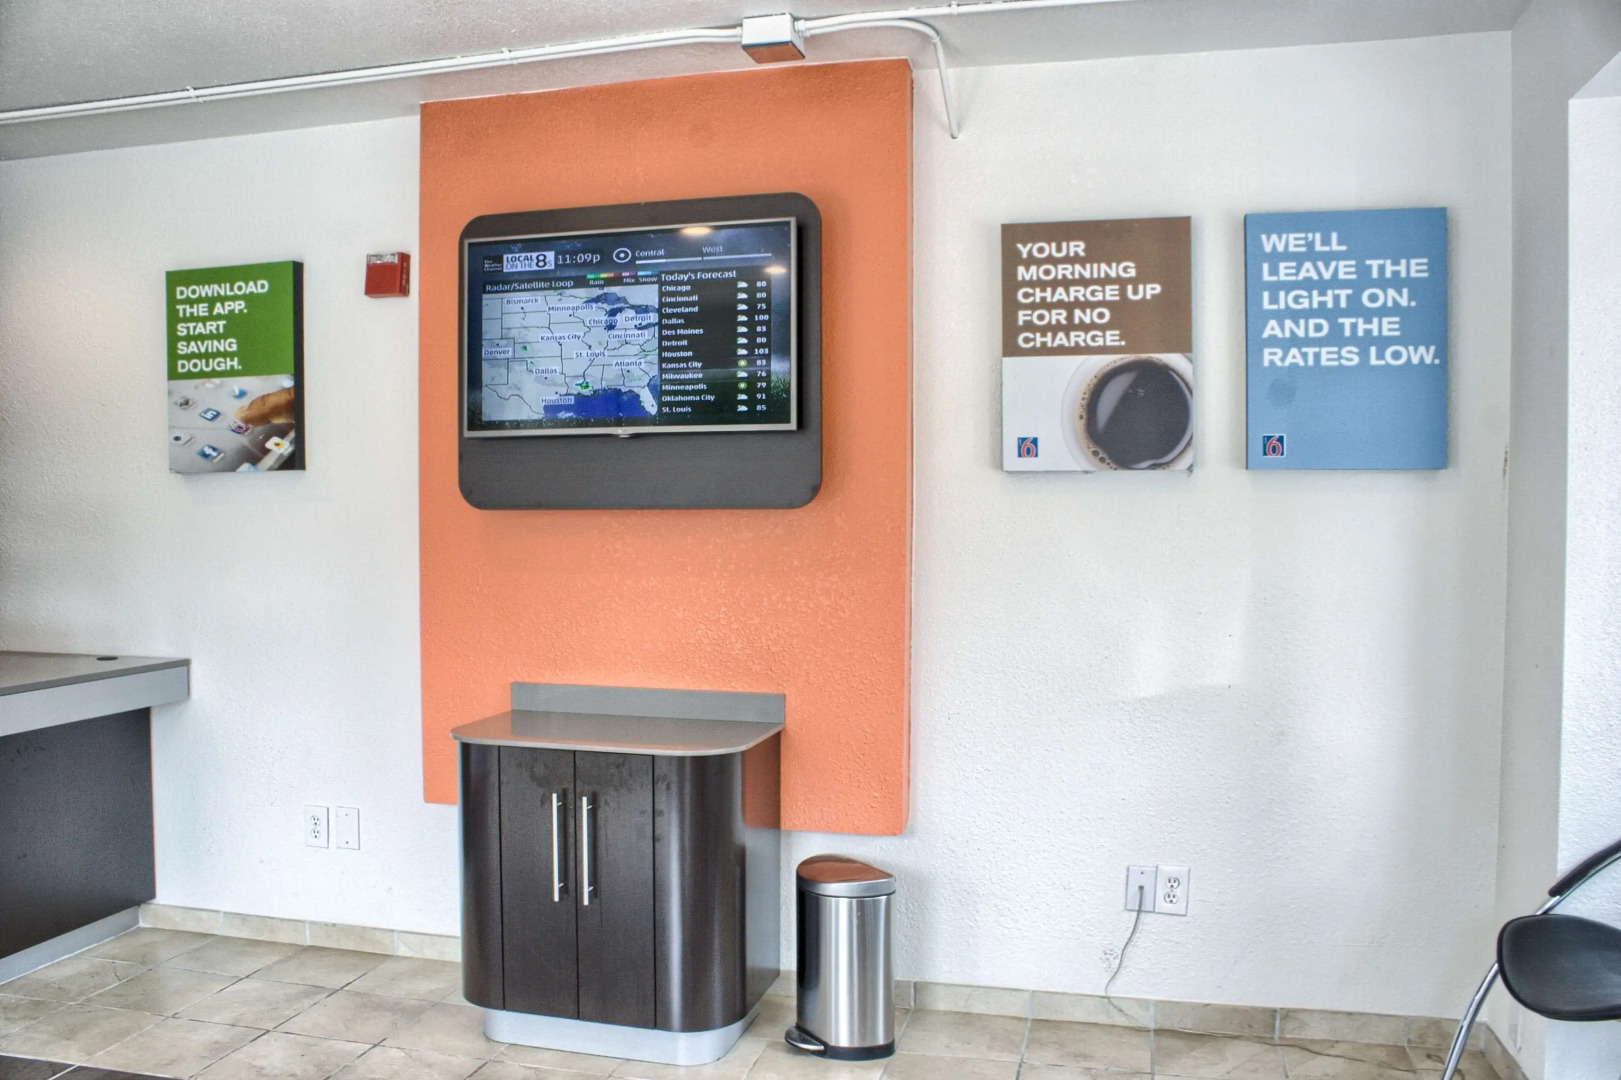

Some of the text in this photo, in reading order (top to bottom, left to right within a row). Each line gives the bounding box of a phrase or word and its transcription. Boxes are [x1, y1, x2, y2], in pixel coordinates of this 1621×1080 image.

[1261, 232, 1347, 253] WE'LL
[635, 246, 724, 258] Central West
[1016, 241, 1086, 259] YOUR
[506, 255, 534, 263] LOCAL
[506, 261, 534, 270] ON THE
[557, 253, 601, 265] 11:09p
[661, 270, 737, 282] Today's Forecast
[1017, 262, 1137, 281] MORNING
[1262, 258, 1429, 281] LEAVE THE
[176, 279, 269, 300] DOWNLOAD
[486, 279, 574, 292] Radar/Satellite Loop
[662, 285, 691, 293] Chicago
[662, 295, 698, 303] Cincinnati
[1017, 283, 1161, 304] CHARGE UP
[1262, 288, 1416, 310] LIGHT ON.
[506, 297, 540, 305] Bismarck
[176, 301, 248, 318] THE APP.
[548, 304, 594, 313] Minneapolis
[662, 306, 699, 314] Cleveland
[588, 318, 618, 326] Chicago
[1017, 308, 1111, 326] FOR NO
[177, 320, 227, 337] START
[1261, 317, 1401, 339] AND THE
[567, 333, 582, 342] City
[1017, 330, 1125, 348] CHARGE.
[177, 338, 238, 355] SAVING
[662, 350, 693, 358] Houston
[1263, 345, 1440, 367] RATES LOW.
[177, 357, 242, 373] DOUGH.
[688, 361, 702, 370] City
[662, 372, 703, 380] Milwaukee
[662, 383, 707, 392] Minneapolis
[662, 394, 700, 402] Oklahoma
[701, 394, 715, 402] City
[1021, 437, 1036, 458] 6
[1265, 435, 1282, 456] 6
